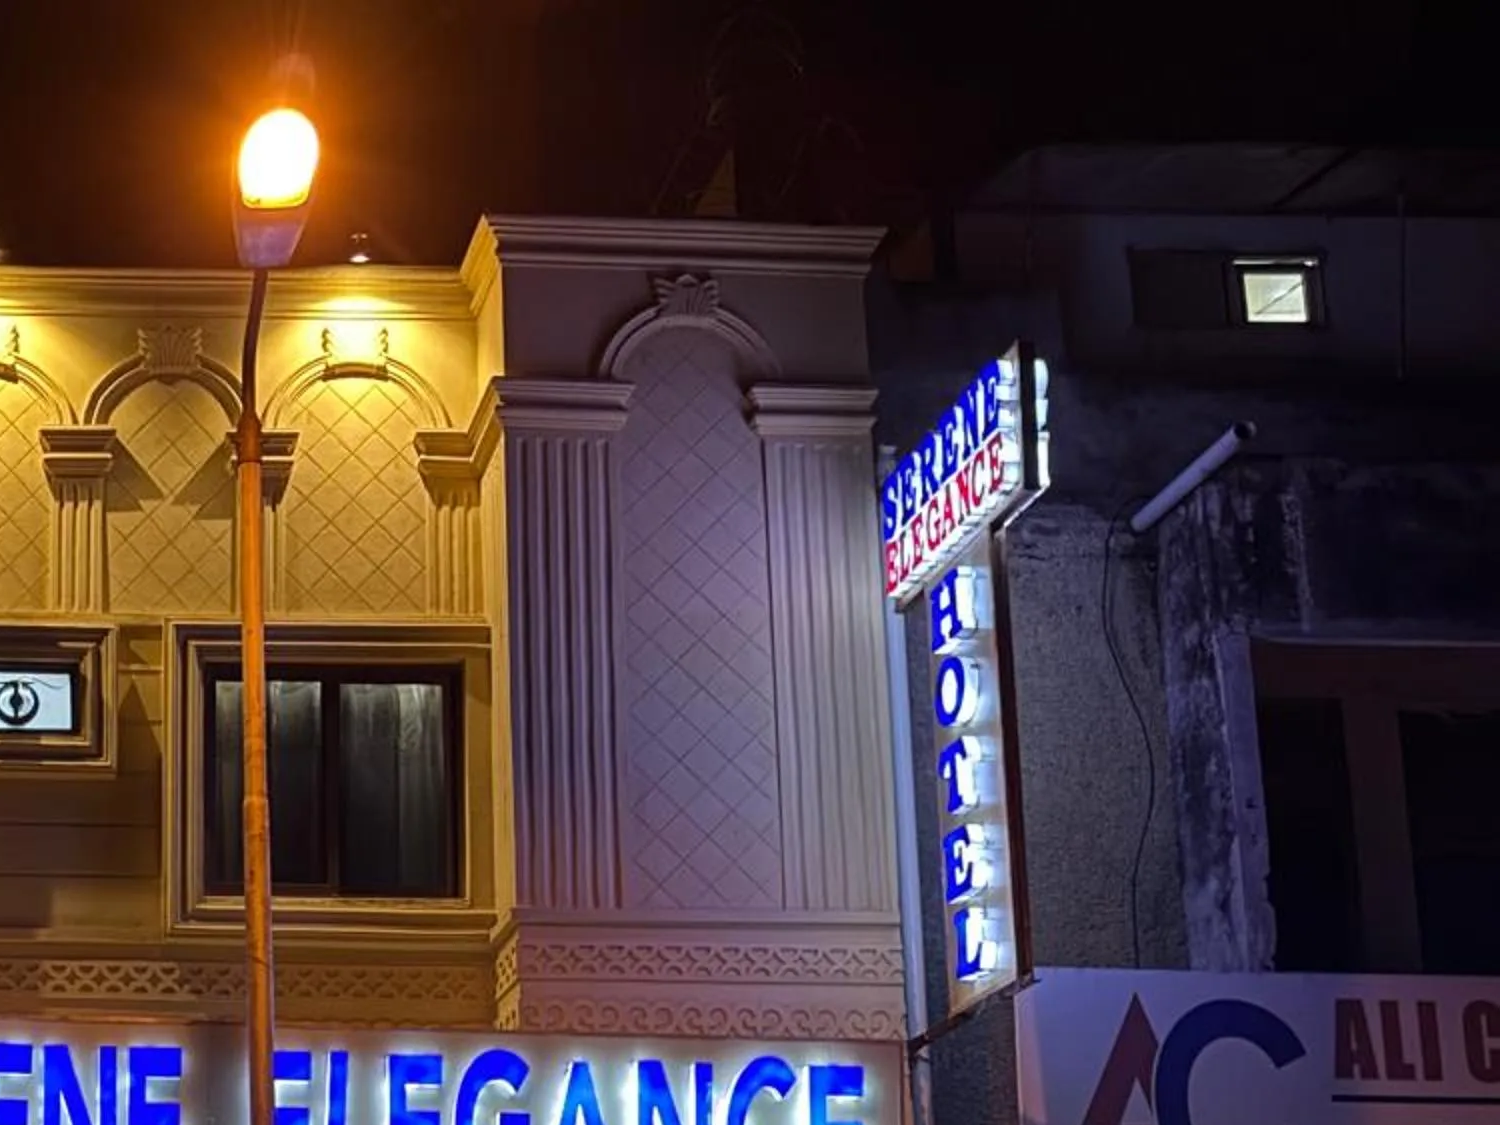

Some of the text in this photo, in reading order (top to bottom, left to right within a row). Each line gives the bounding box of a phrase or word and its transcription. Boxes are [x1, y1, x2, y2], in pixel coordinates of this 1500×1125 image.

[883, 358, 1002, 542] SERENE
[885, 432, 1006, 597] ELEGANCE
[930, 565, 988, 983] HOTEL
[1334, 998, 1443, 1082] ALI
